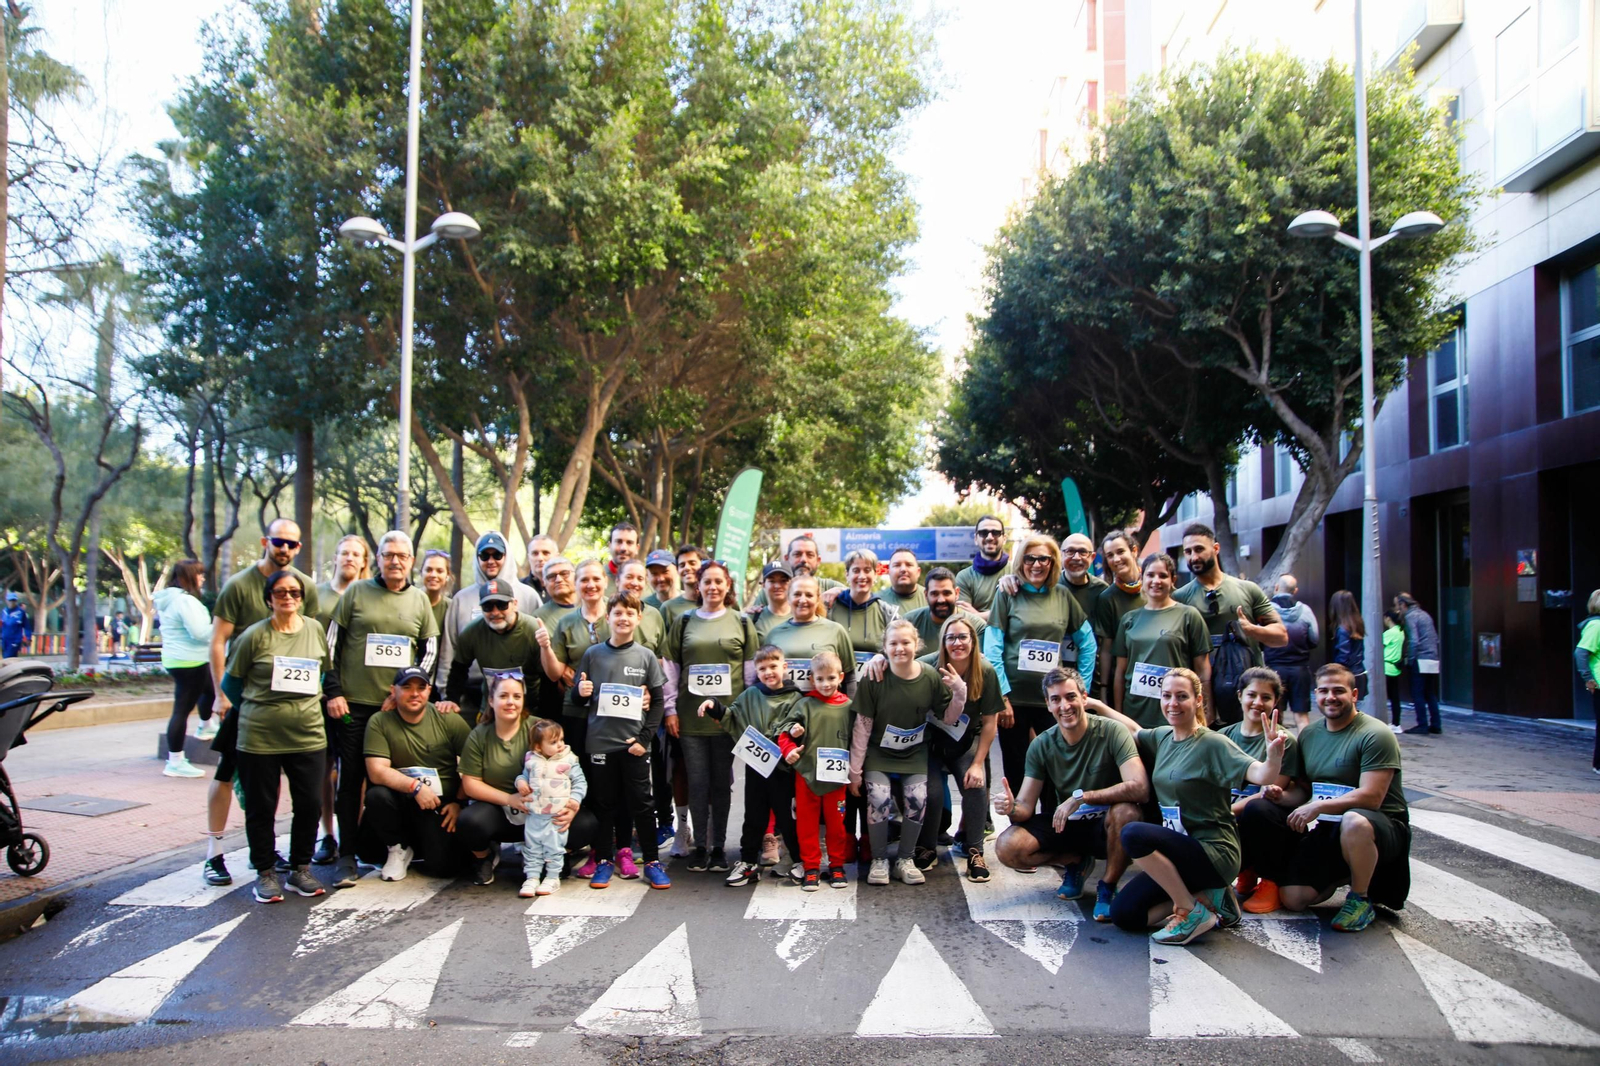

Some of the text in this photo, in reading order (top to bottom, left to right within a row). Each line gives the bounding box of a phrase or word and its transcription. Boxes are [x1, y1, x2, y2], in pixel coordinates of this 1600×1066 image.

[845, 531, 881, 540] Almería
[845, 541, 920, 550] contra el cáncer
[375, 644, 402, 657] 563
[1027, 650, 1053, 663] 530
[283, 668, 310, 682] 223
[696, 674, 722, 686] 529
[612, 694, 630, 707] 93
[892, 733, 918, 744] 160
[745, 740, 771, 763] 250
